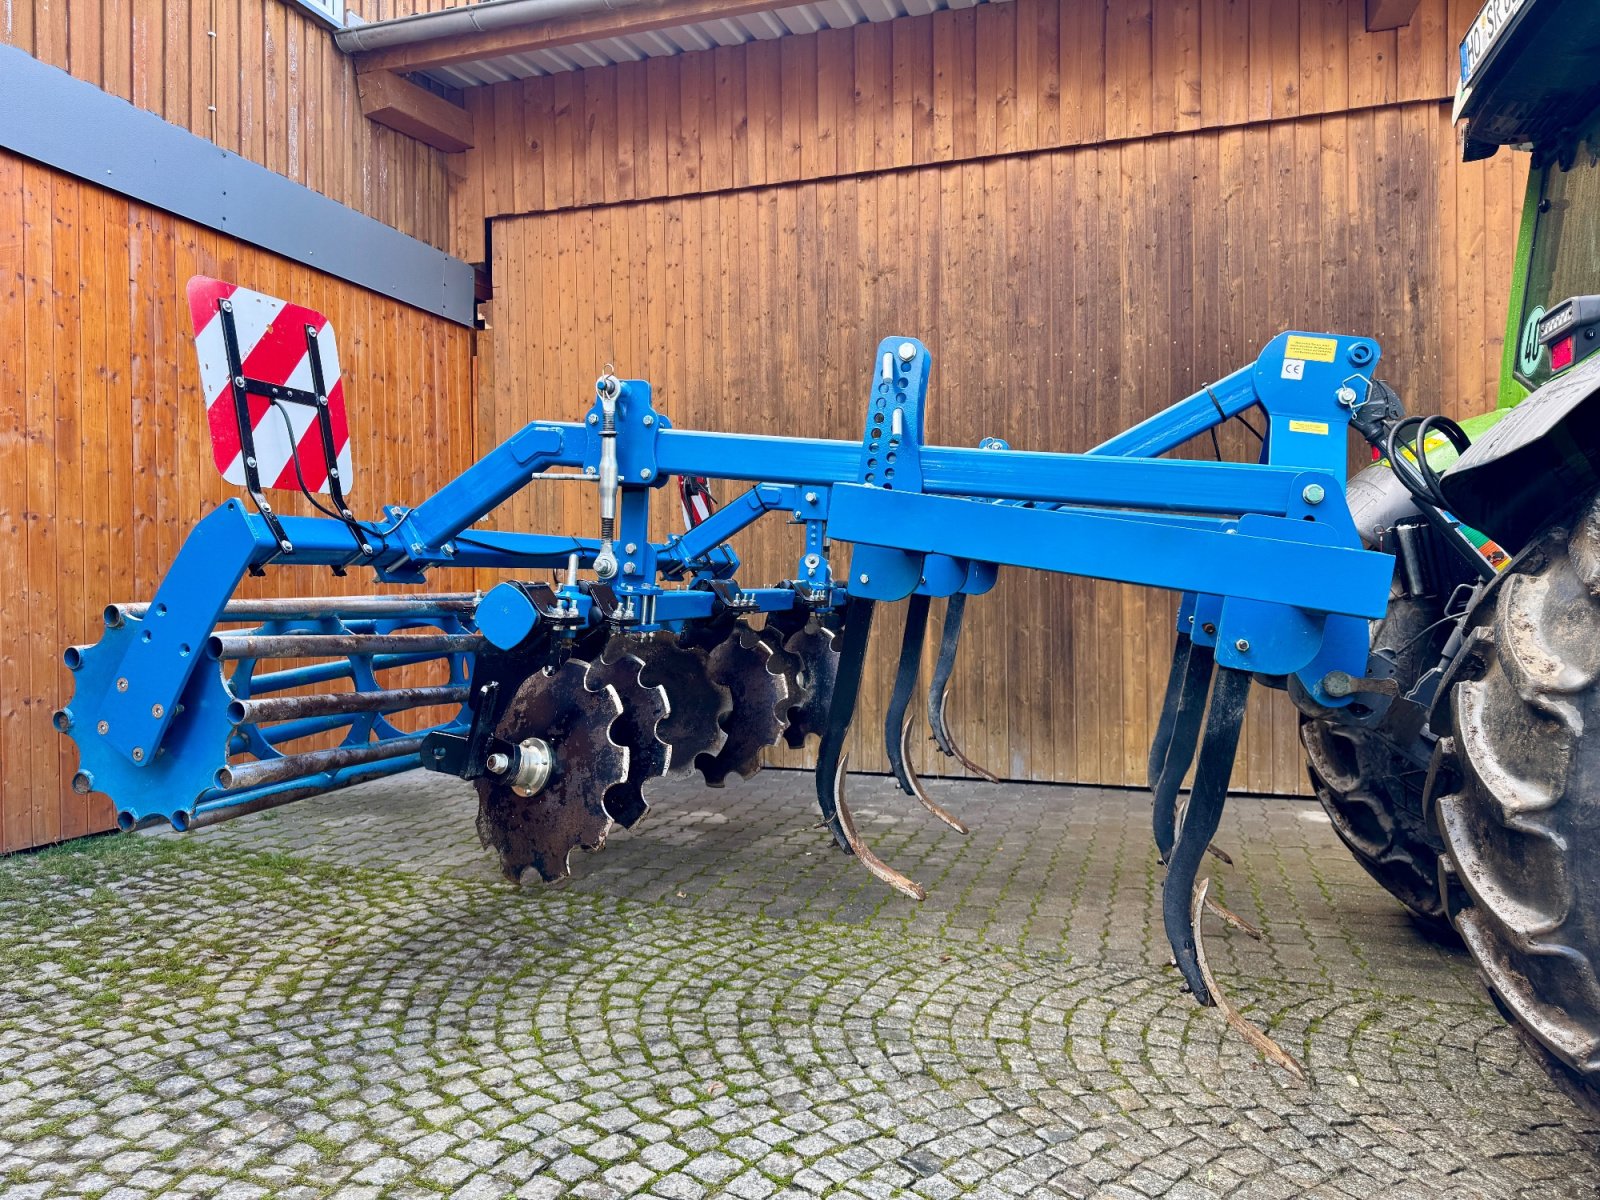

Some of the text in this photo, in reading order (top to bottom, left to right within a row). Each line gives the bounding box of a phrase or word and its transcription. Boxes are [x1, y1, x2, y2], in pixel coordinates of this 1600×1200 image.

[1467, 0, 1502, 70] HO SR
[1525, 318, 1541, 363] 40
[1285, 364, 1300, 375] CE
